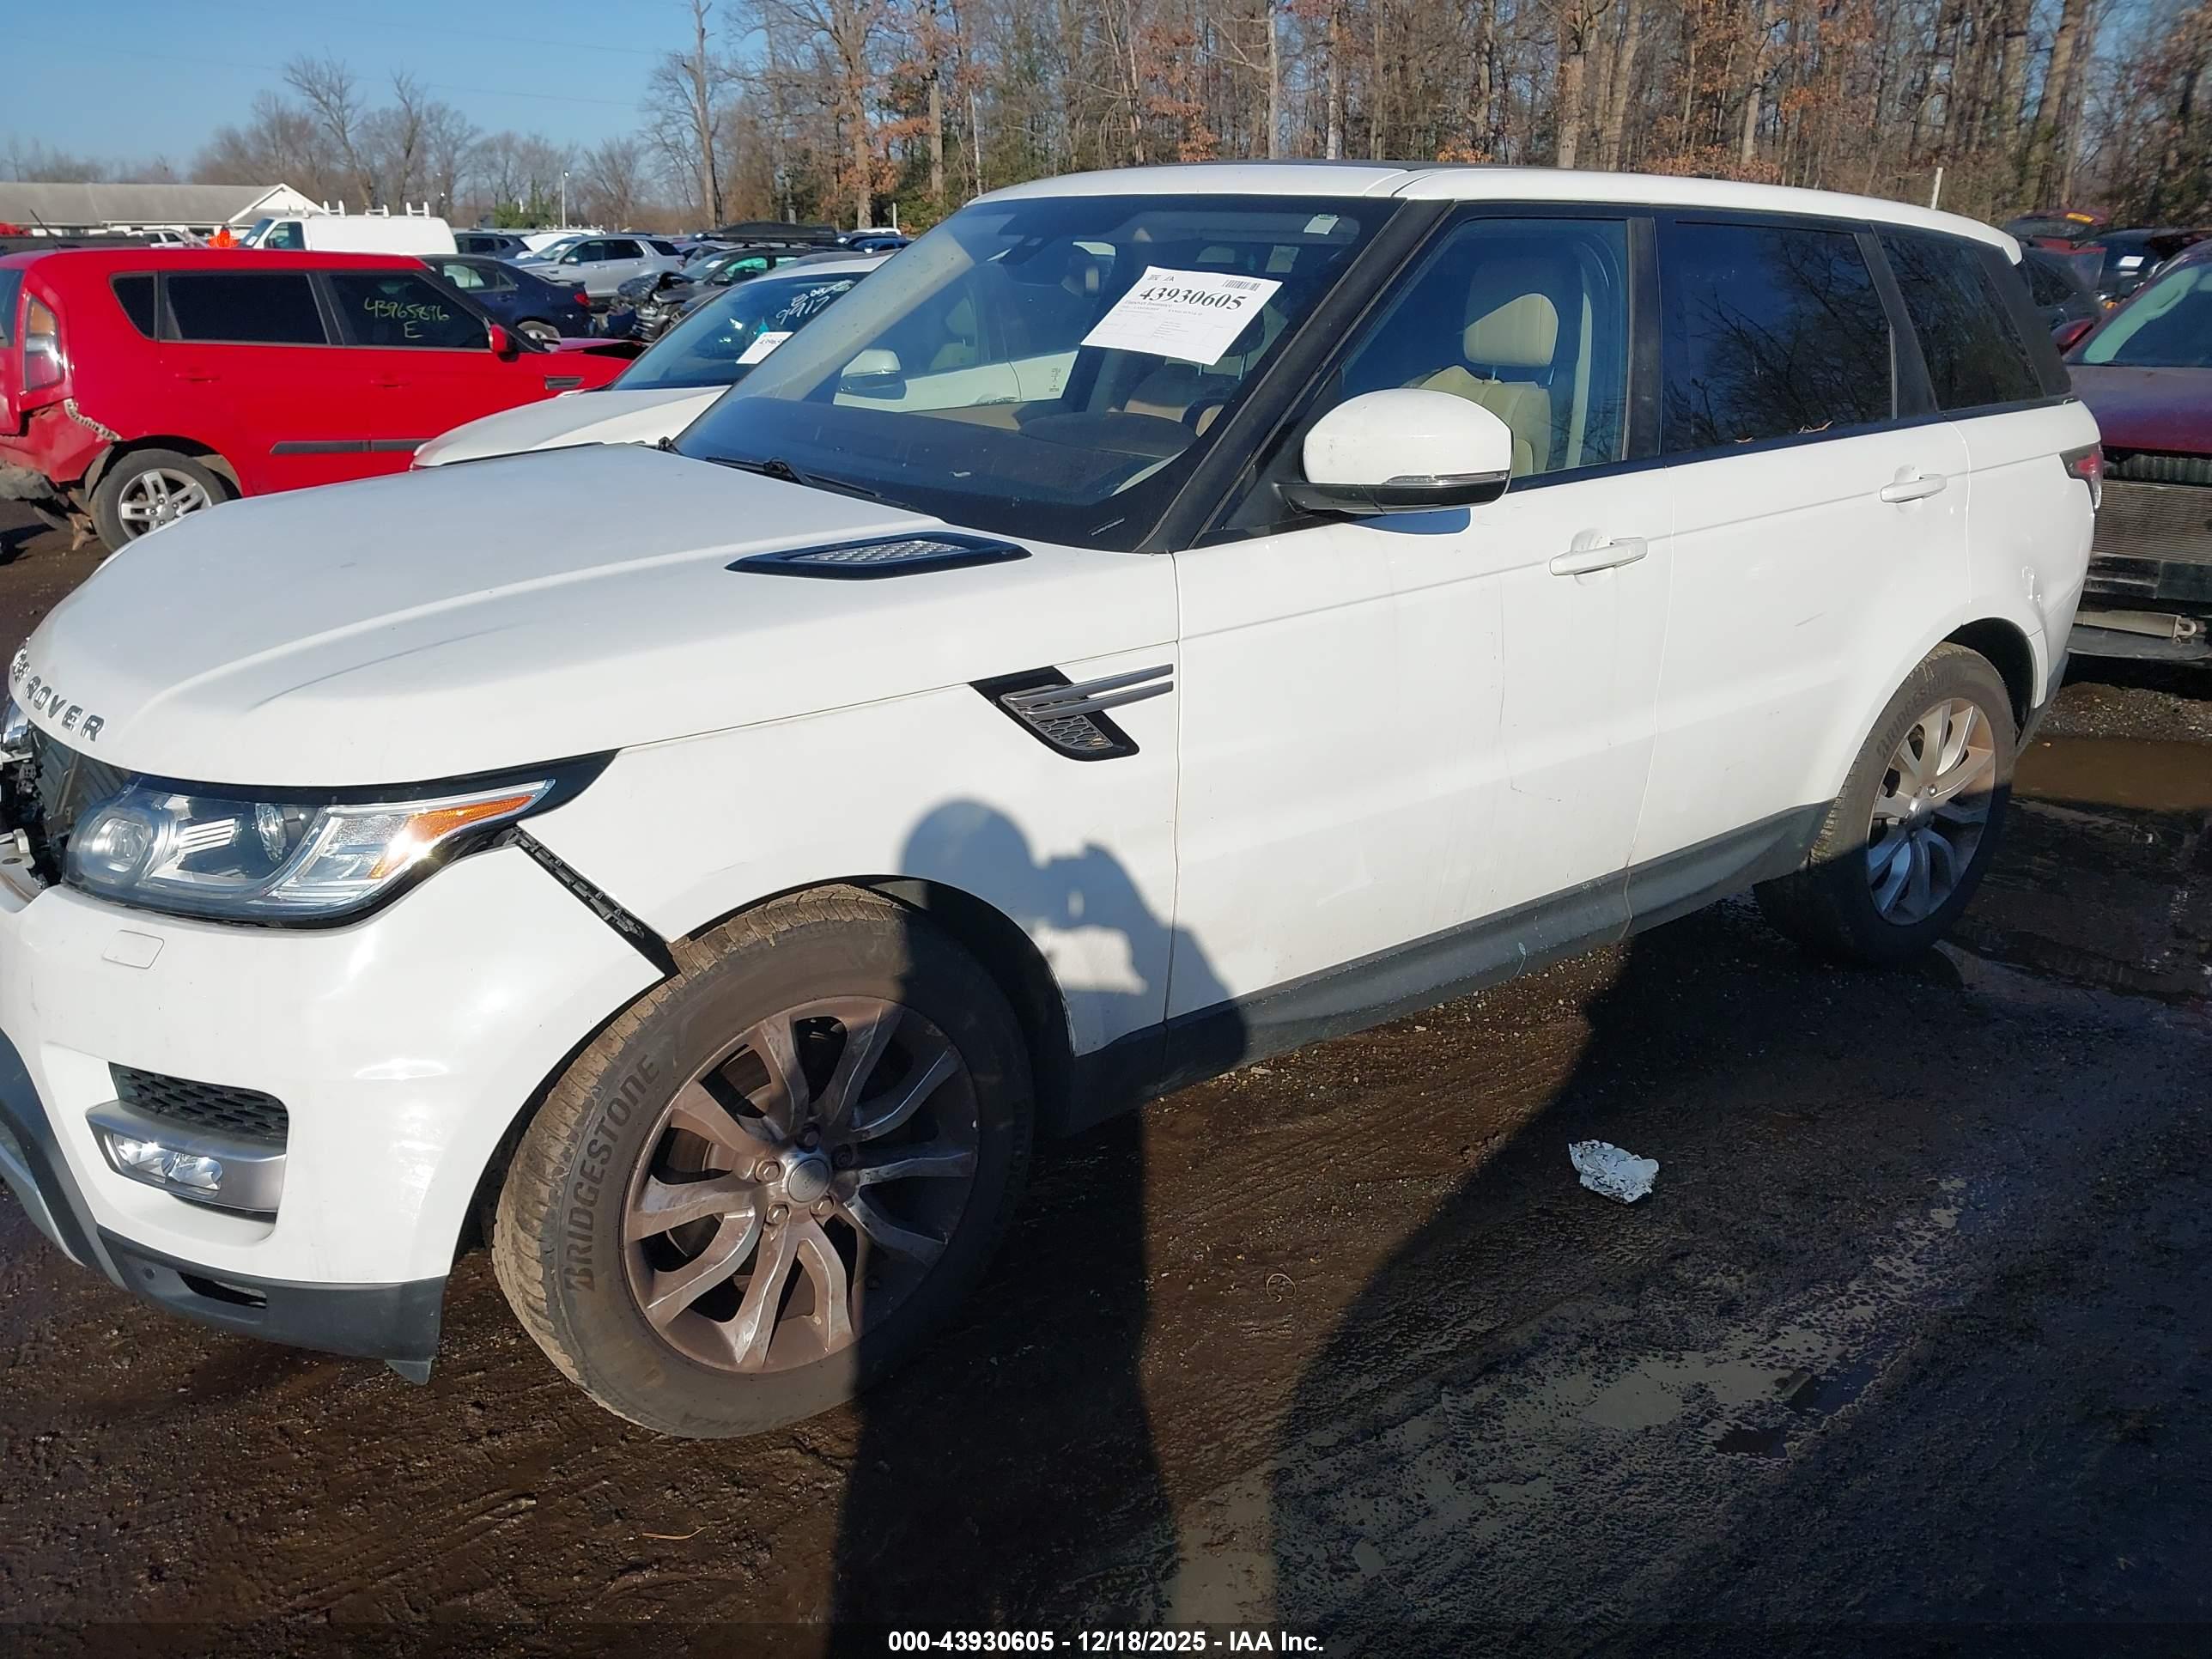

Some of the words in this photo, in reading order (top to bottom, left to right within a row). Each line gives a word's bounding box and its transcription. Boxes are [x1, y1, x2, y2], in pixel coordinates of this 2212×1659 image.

[364, 297, 450, 321] 43965896
[1139, 286, 1249, 311] 43930605
[404, 320, 425, 339] E
[24, 675, 105, 743] ROVER
[562, 1054, 660, 1292] BRIDGESTONE
